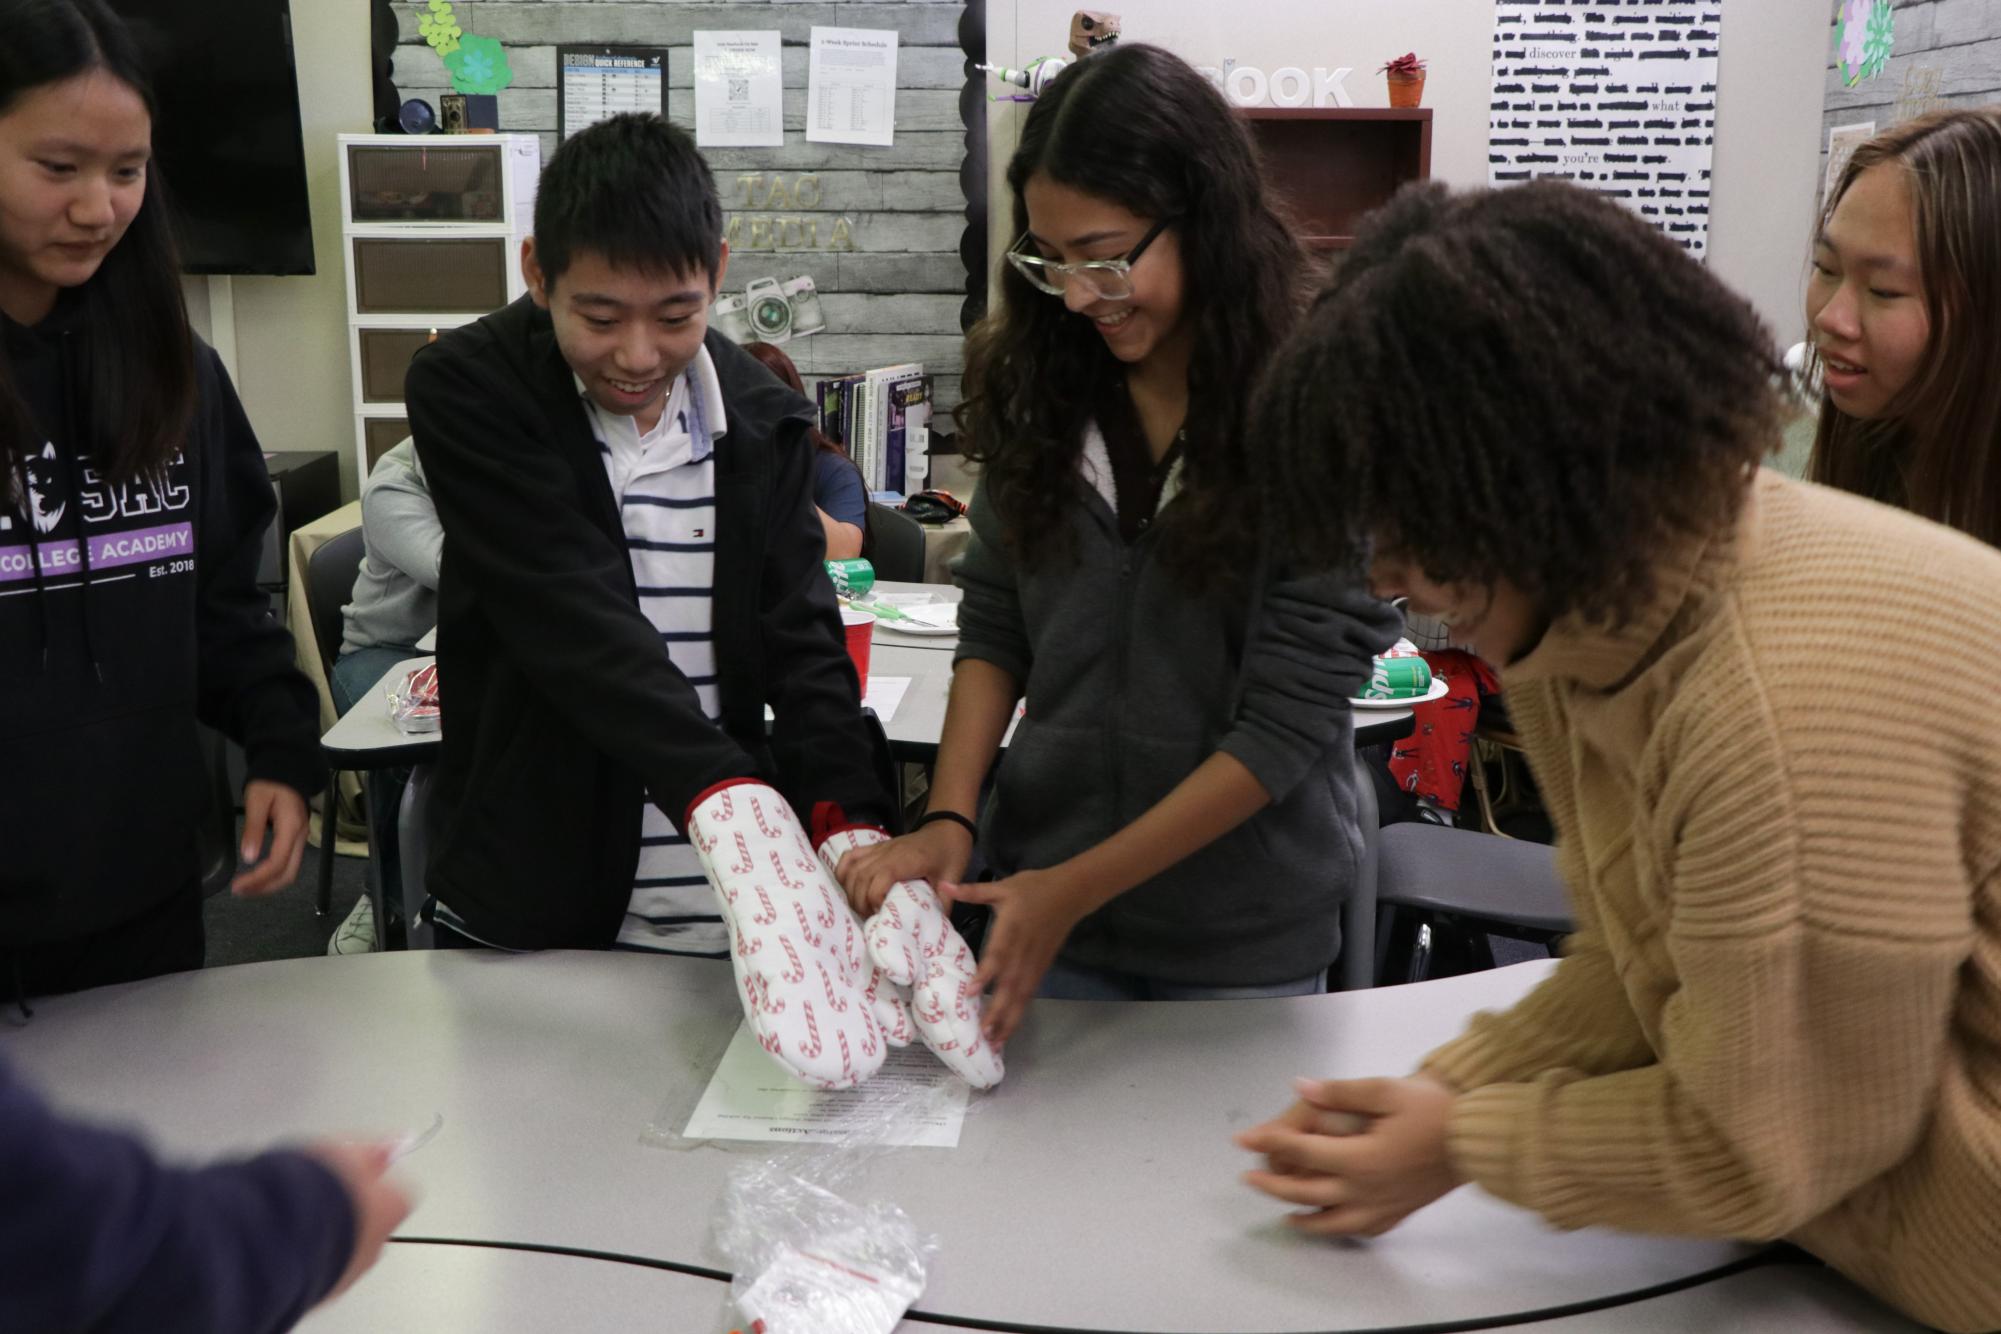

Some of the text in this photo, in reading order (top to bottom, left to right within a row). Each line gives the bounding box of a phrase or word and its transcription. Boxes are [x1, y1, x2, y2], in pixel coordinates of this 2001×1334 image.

[1529, 50, 1576, 60] discover
[1196, 66, 1354, 108] OOK
[1652, 101, 1680, 111] what
[1563, 152, 1599, 164] you're
[101, 531, 189, 561] ACADEMY
[150, 560, 195, 578] Est. 2018
